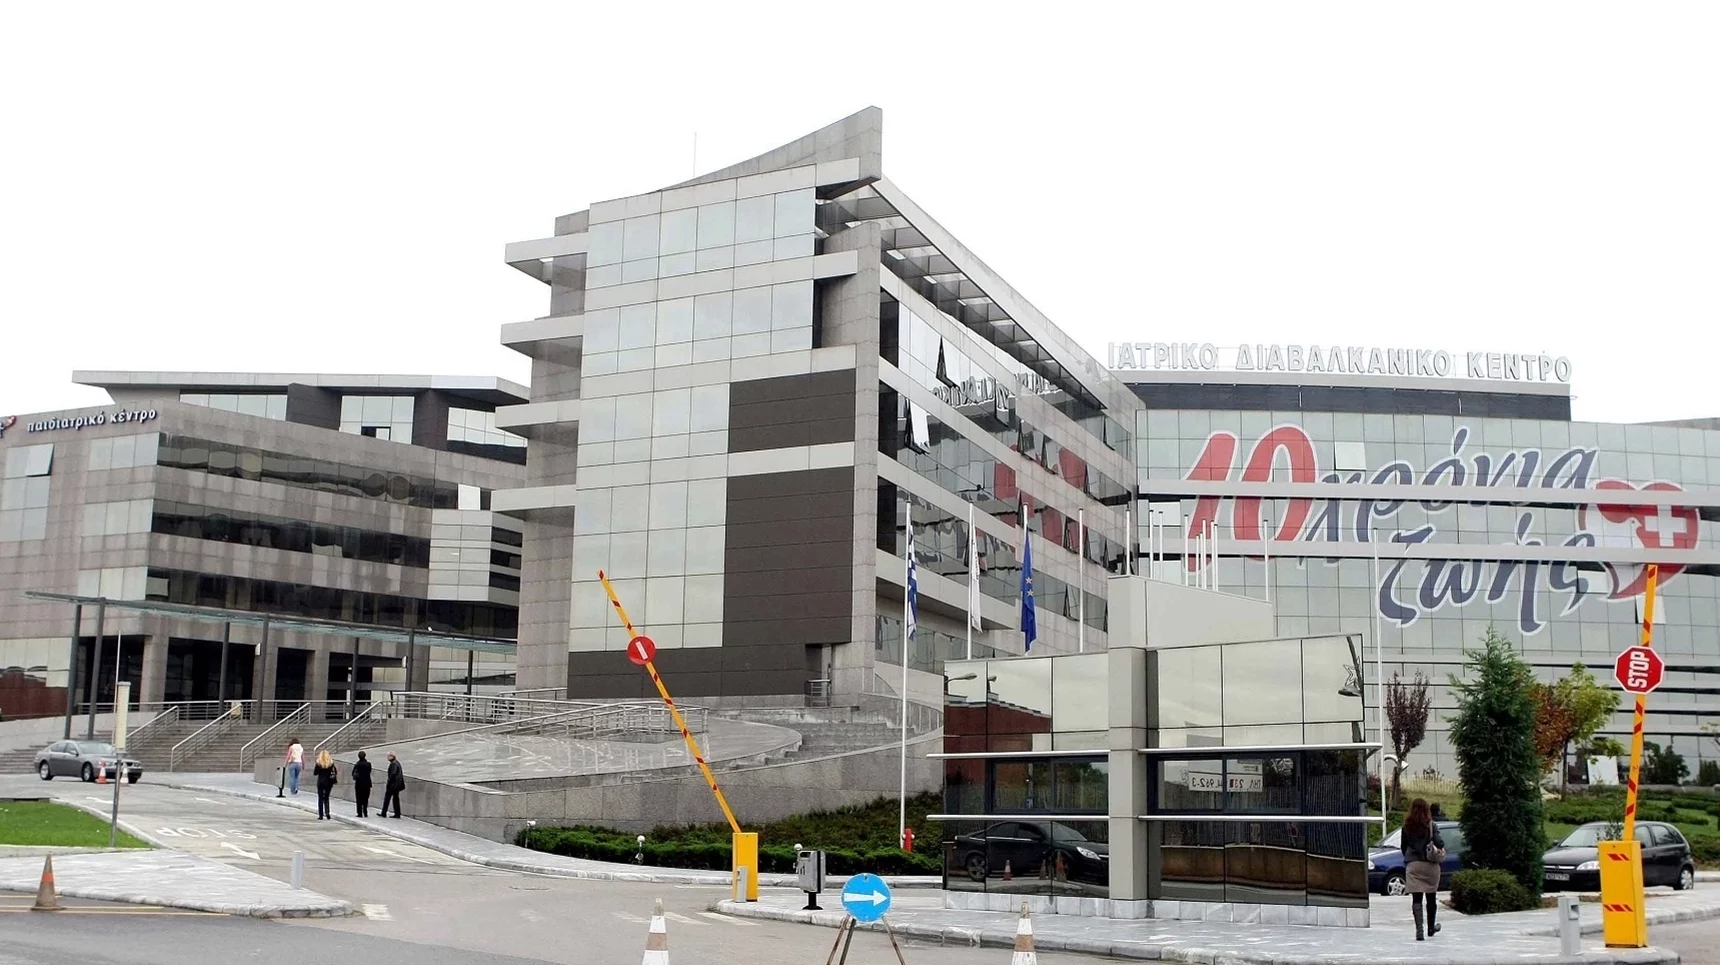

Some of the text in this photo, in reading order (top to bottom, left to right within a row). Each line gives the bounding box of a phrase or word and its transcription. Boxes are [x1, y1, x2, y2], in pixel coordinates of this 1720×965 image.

[1107, 342, 1572, 382] ΙΑΤΡΙΚΟ ΔΙΑΒΑΛΚΑΝΙΚΟ ΚΕΝΤΡΟ
[26, 409, 157, 433] παιδιατρικό κέντρο
[1183, 424, 1318, 572] 10
[1627, 650, 1650, 689] STOP
[155, 827, 258, 839] STOP
